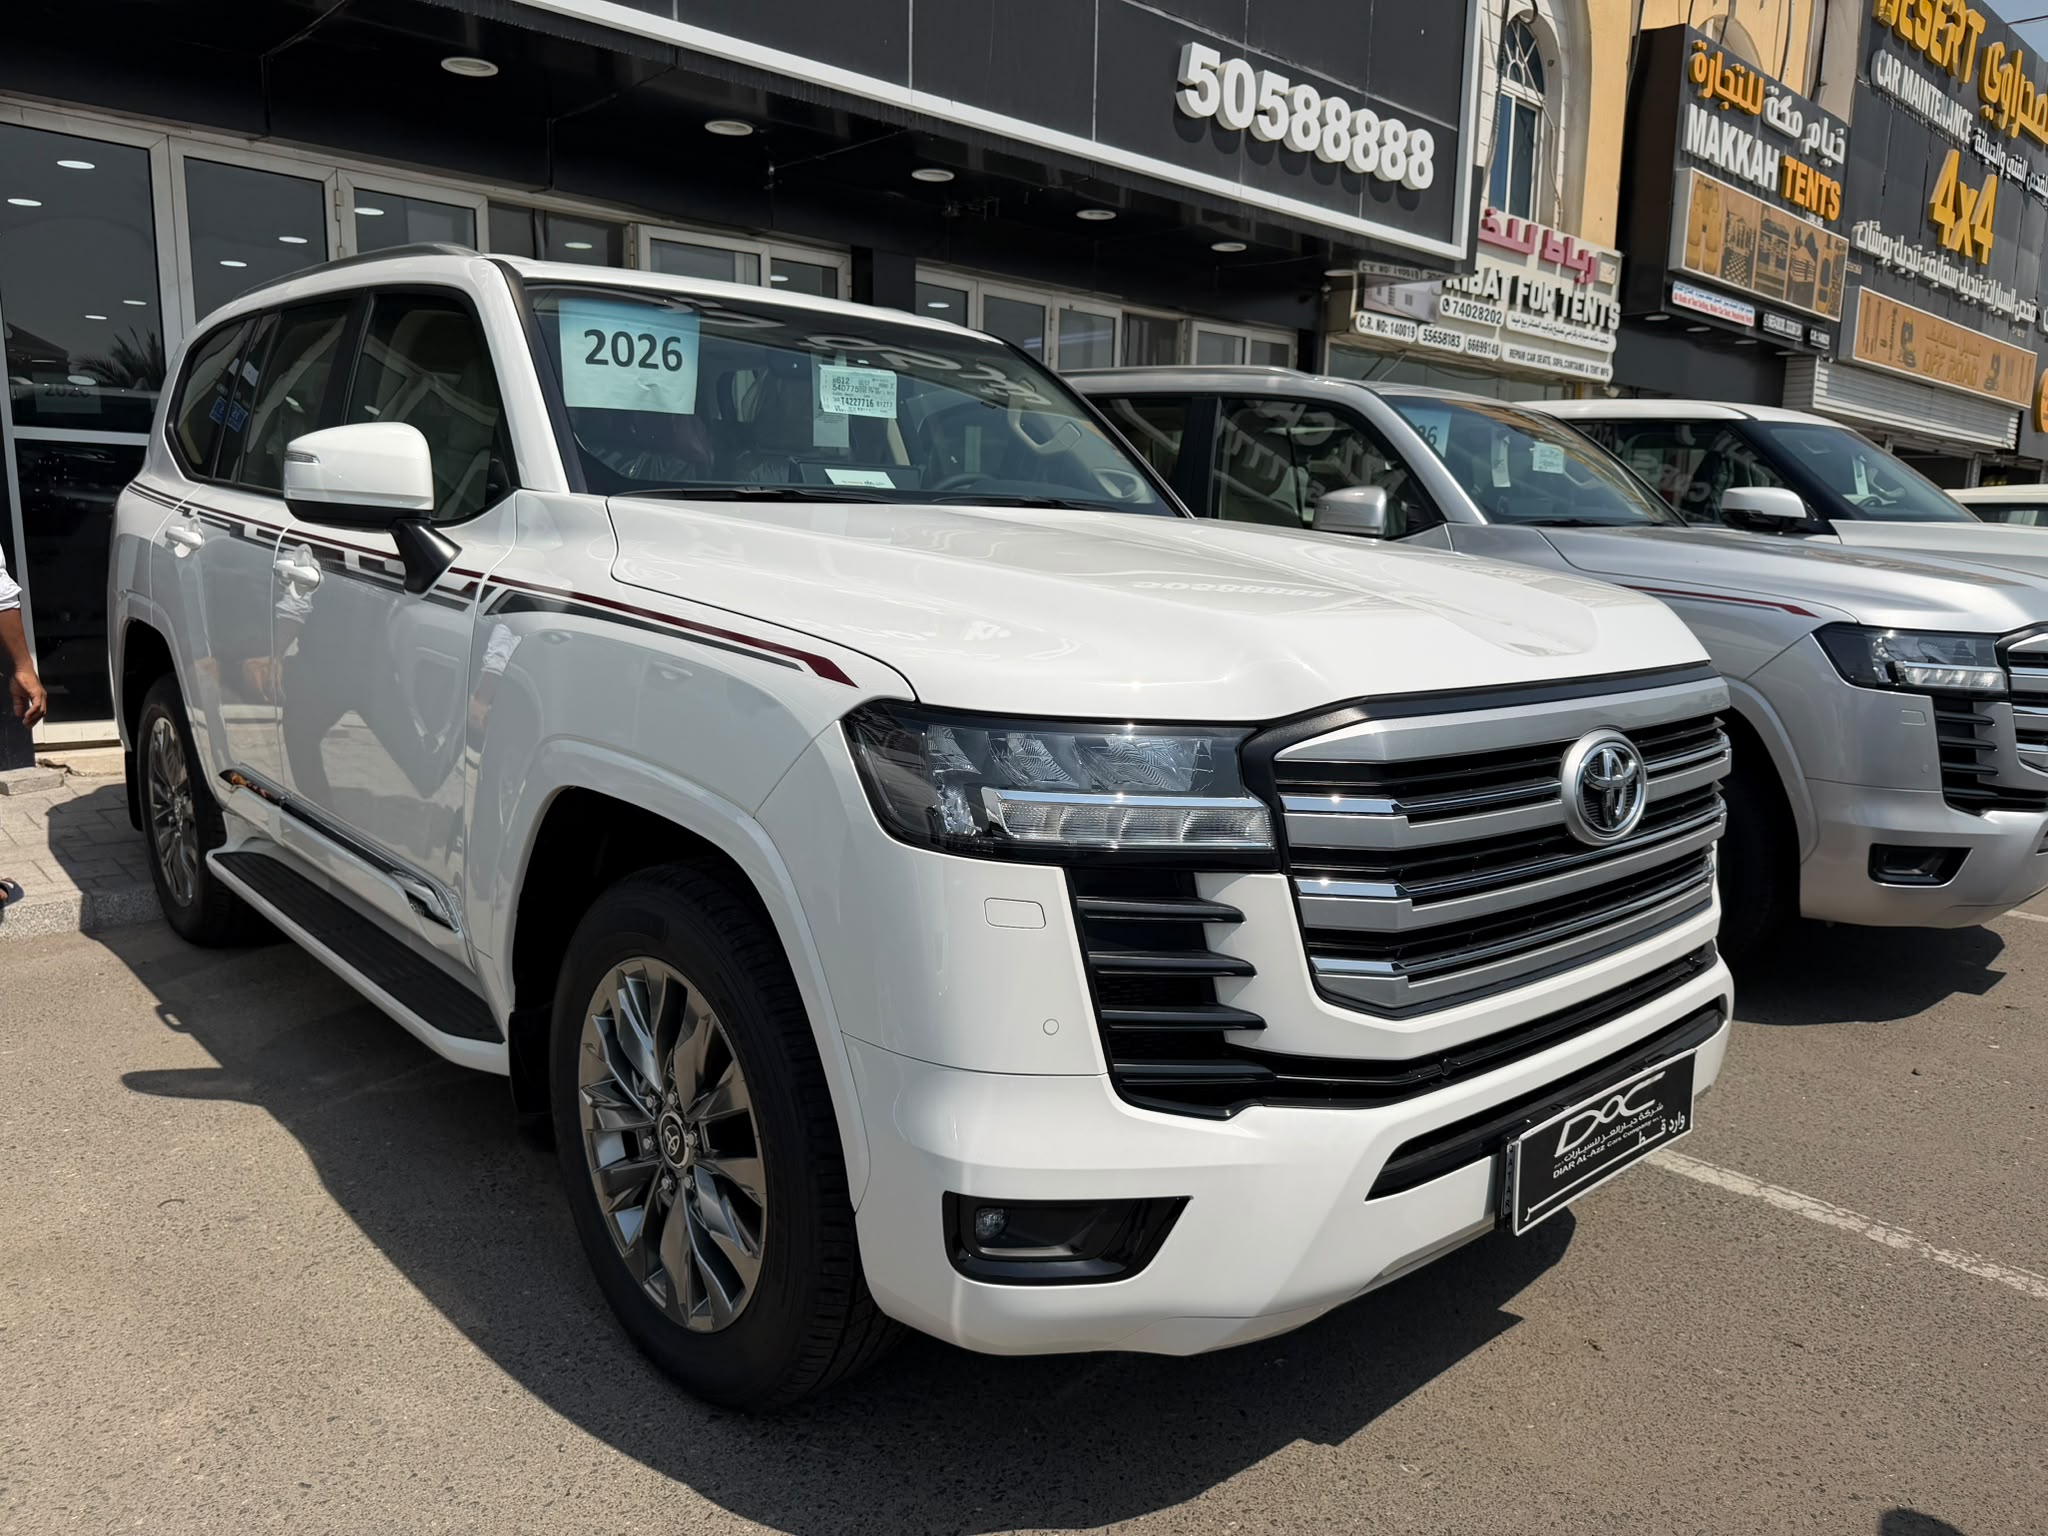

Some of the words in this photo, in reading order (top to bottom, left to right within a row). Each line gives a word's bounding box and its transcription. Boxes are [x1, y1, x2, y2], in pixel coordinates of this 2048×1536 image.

[1689, 40, 1764, 116] للتجارة
[1871, 49, 1900, 94] CAR
[1902, 65, 1973, 144] MAINTENANCE
[1176, 41, 1434, 190] 50588888
[1763, 85, 1803, 139] مكة
[1682, 103, 1780, 191] MAKKAH
[1779, 154, 1841, 221] TENTS
[1801, 116, 1846, 167] خيام
[1540, 229, 1597, 285] رباط
[1452, 301, 1503, 325] 74028202
[1516, 279, 1556, 313] FOR
[1559, 286, 1621, 331] TENTS
[583, 329, 683, 372] 2026
[1923, 350, 1946, 377] OFF
[1638, 1102, 1664, 1122] شركة
[1553, 1161, 1576, 1179] DIAR
